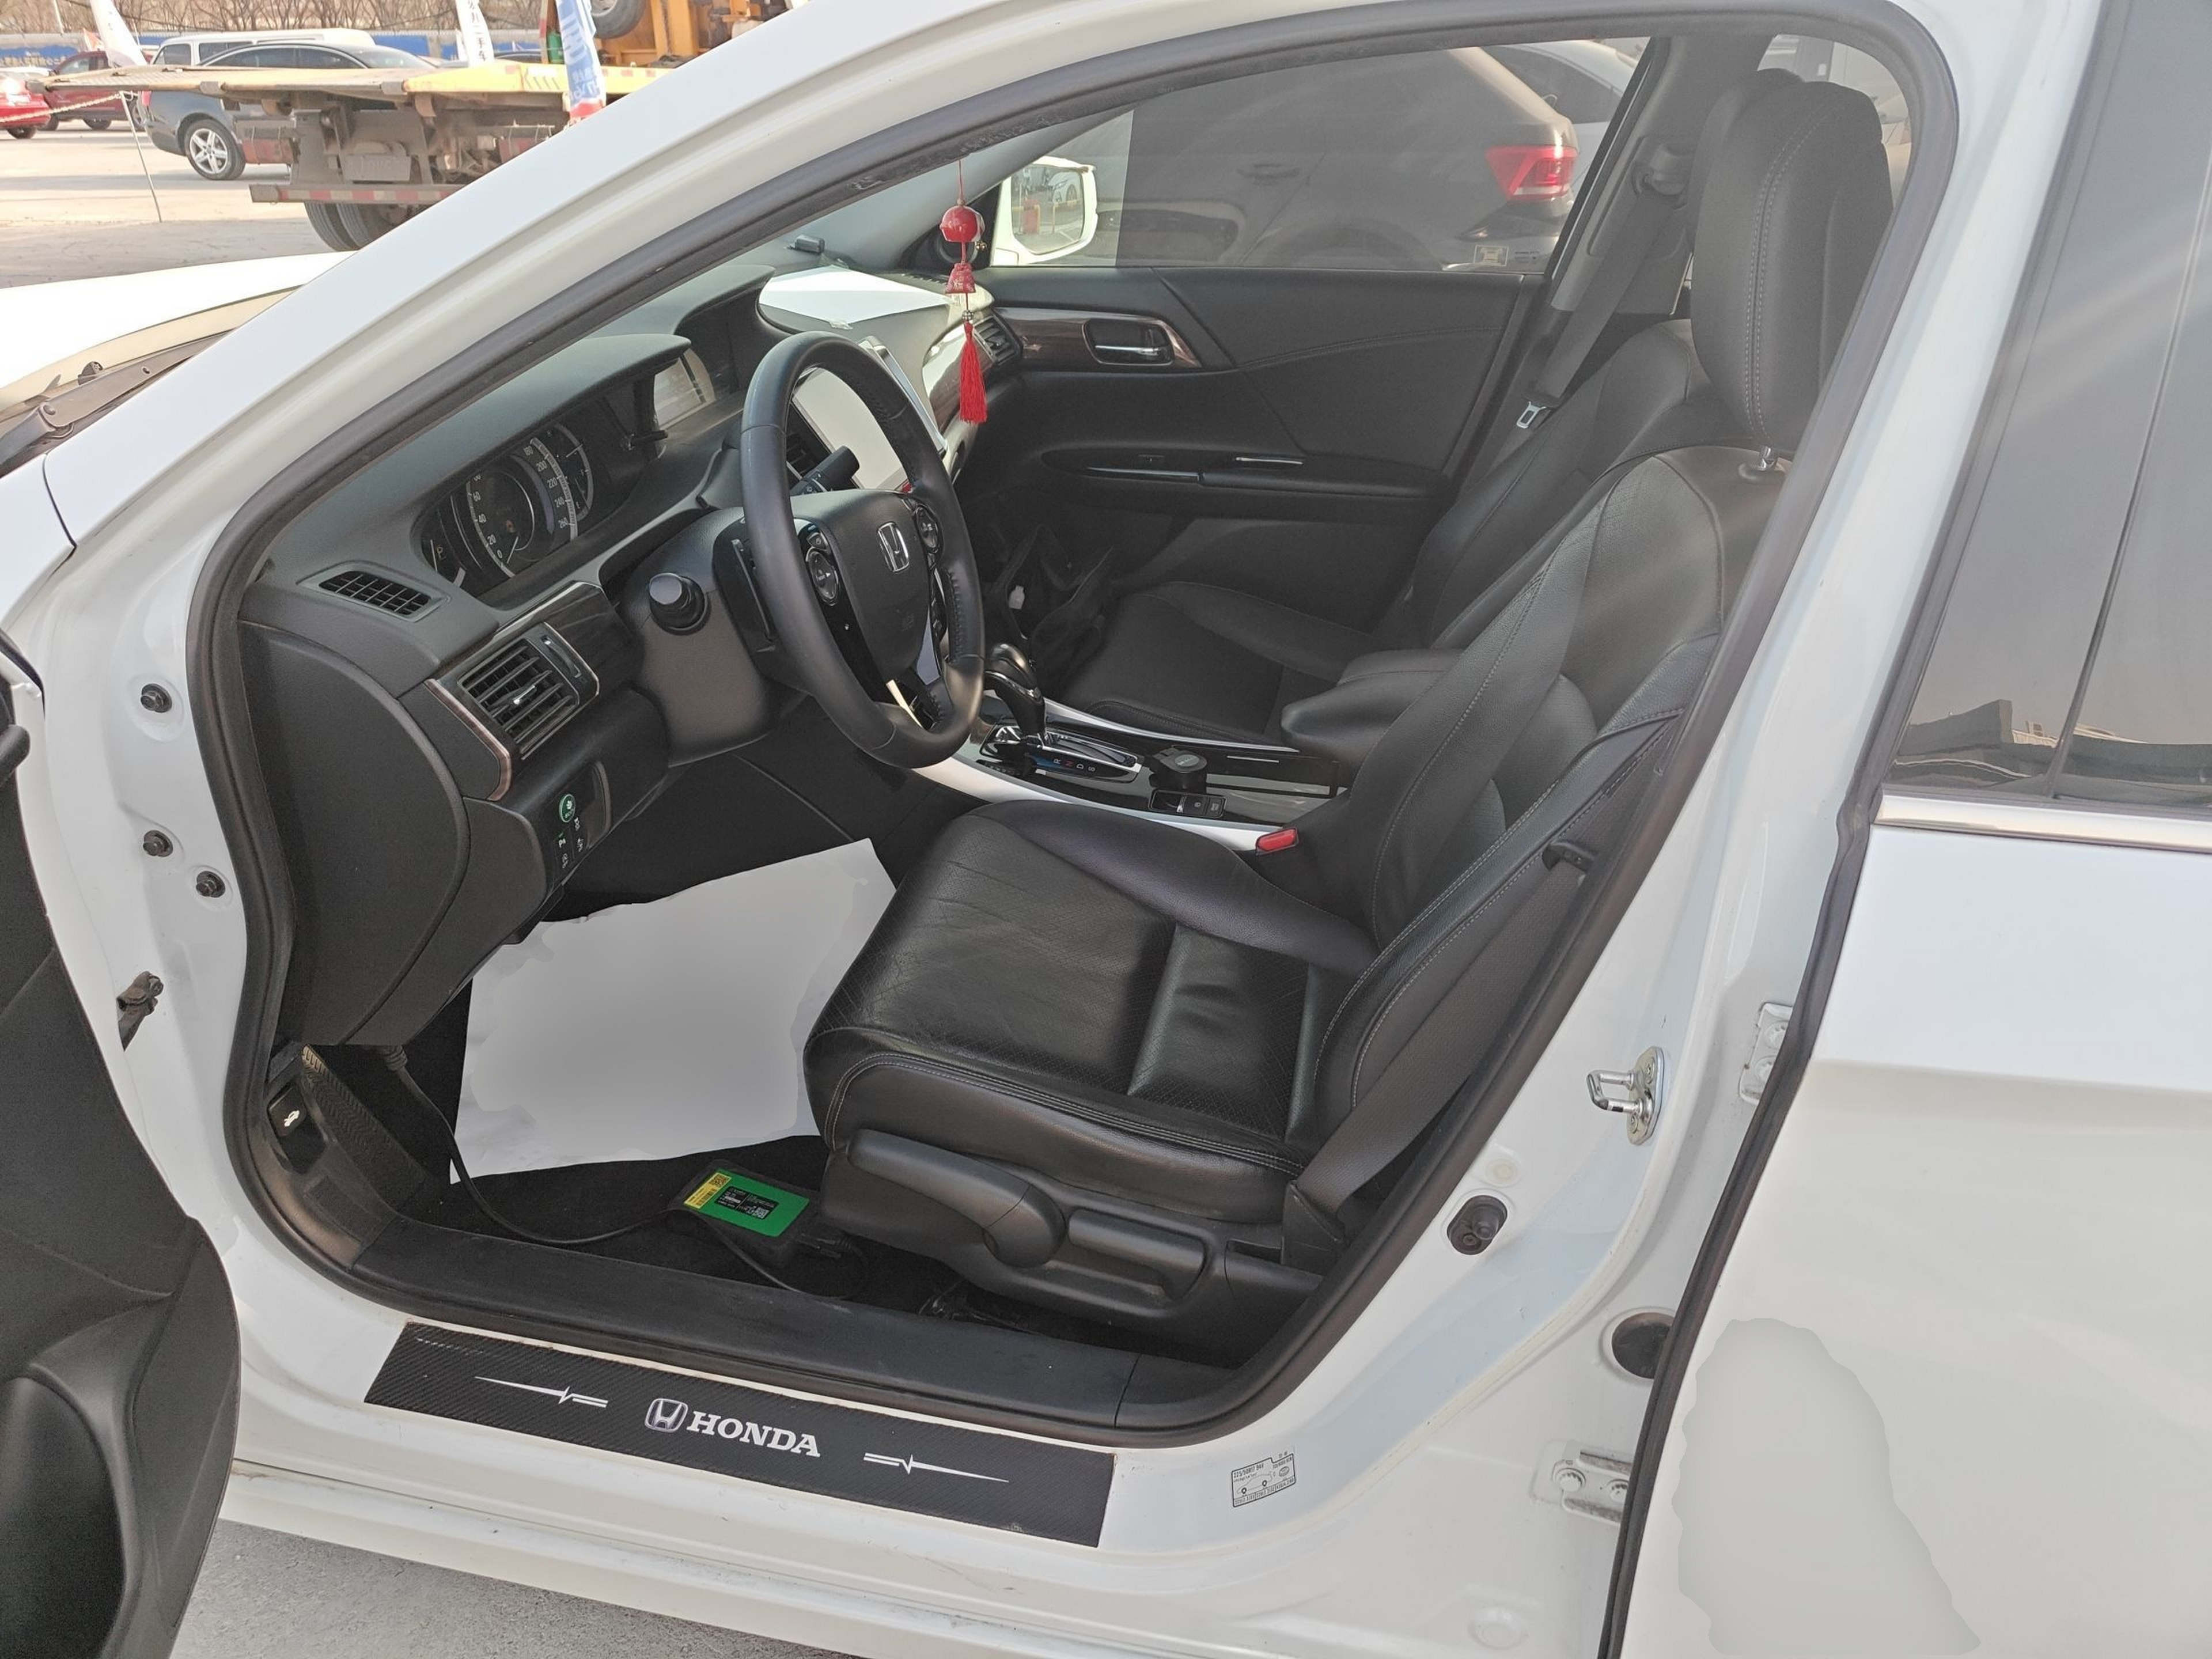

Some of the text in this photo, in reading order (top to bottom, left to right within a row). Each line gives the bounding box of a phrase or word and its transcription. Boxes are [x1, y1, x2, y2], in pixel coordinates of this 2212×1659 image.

[536, 460, 547, 472] 200
[547, 477, 558, 488] 220
[473, 491, 481, 502] 60
[554, 497, 565, 507] 240
[479, 514, 487, 523] 40
[558, 517, 569, 528] 260
[487, 534, 496, 545] 20
[497, 549, 503, 559] 0
[687, 1411, 820, 1457] HONDA
